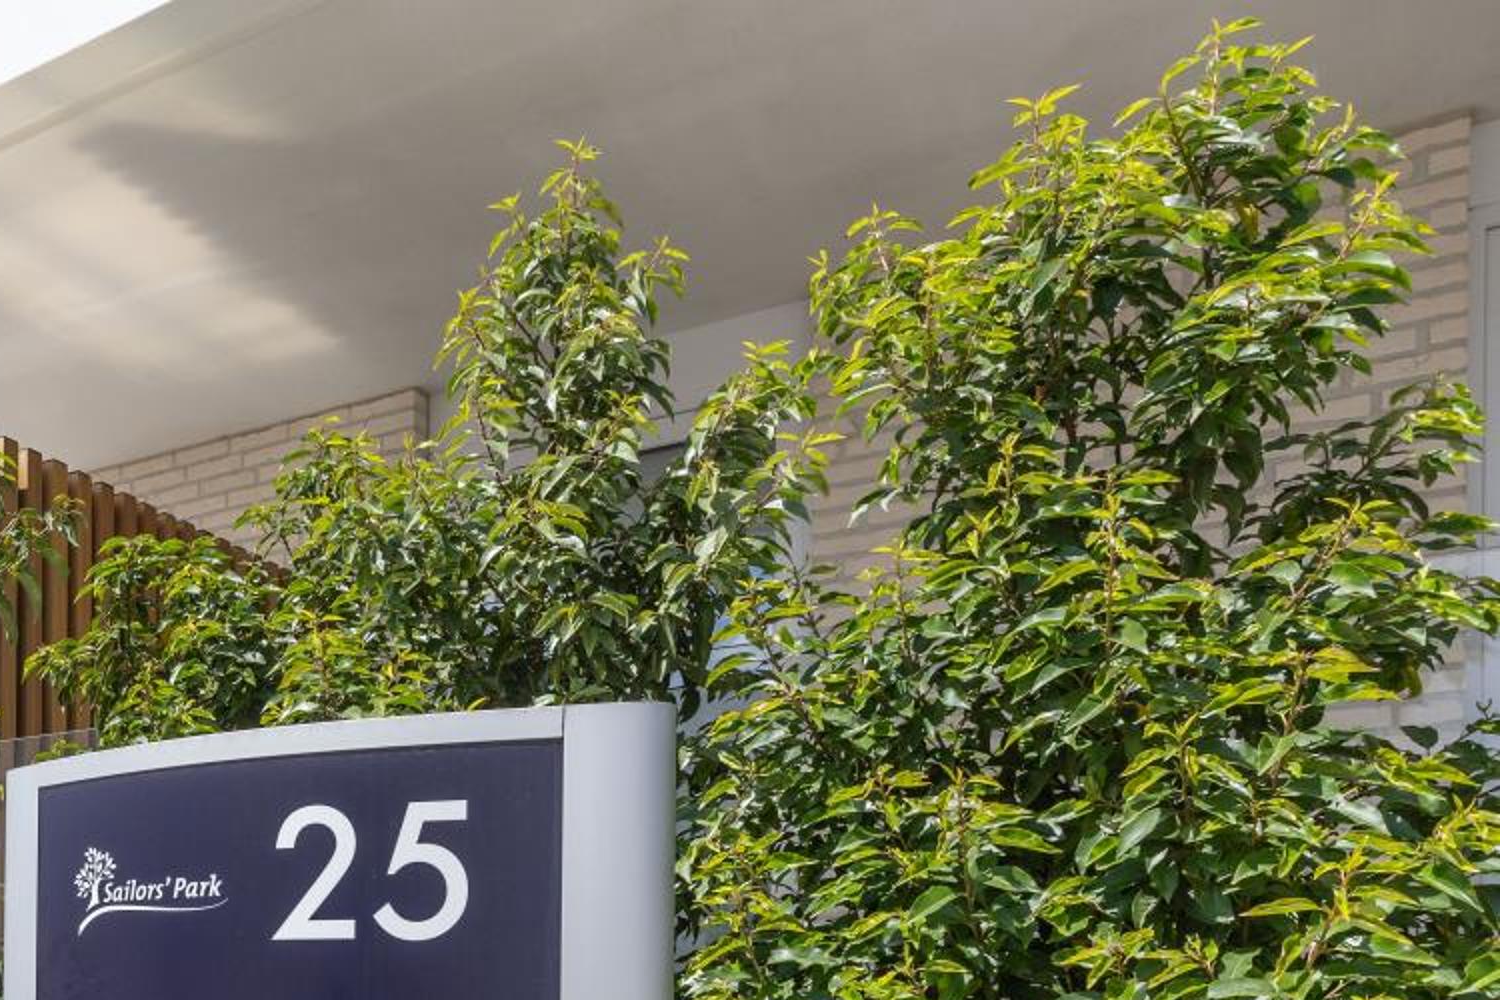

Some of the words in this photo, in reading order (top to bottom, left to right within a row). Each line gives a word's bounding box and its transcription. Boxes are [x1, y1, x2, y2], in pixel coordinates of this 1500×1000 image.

[102, 876, 172, 904] Sailors'
[173, 873, 223, 900] Park
[271, 799, 469, 941] 25
